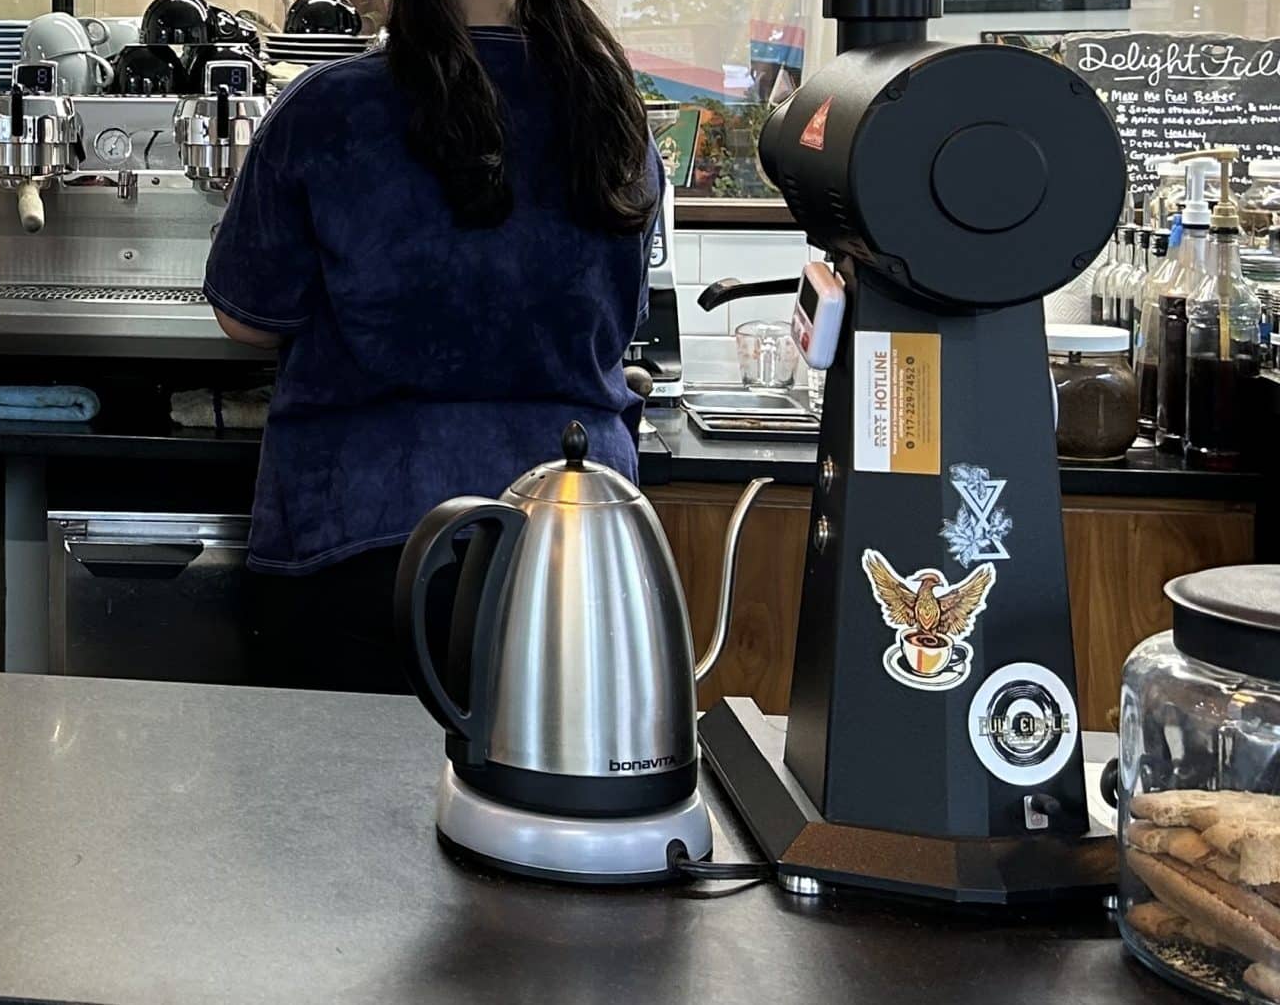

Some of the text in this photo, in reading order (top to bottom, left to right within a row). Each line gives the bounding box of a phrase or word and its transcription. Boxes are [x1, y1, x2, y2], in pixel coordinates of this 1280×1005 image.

[1111, 90, 1139, 103] Make
[1165, 89, 1188, 103] Feel
[1193, 90, 1237, 104] Better
[873, 350, 888, 411] HOTLINE
[905, 366, 916, 438] 717-229-7452
